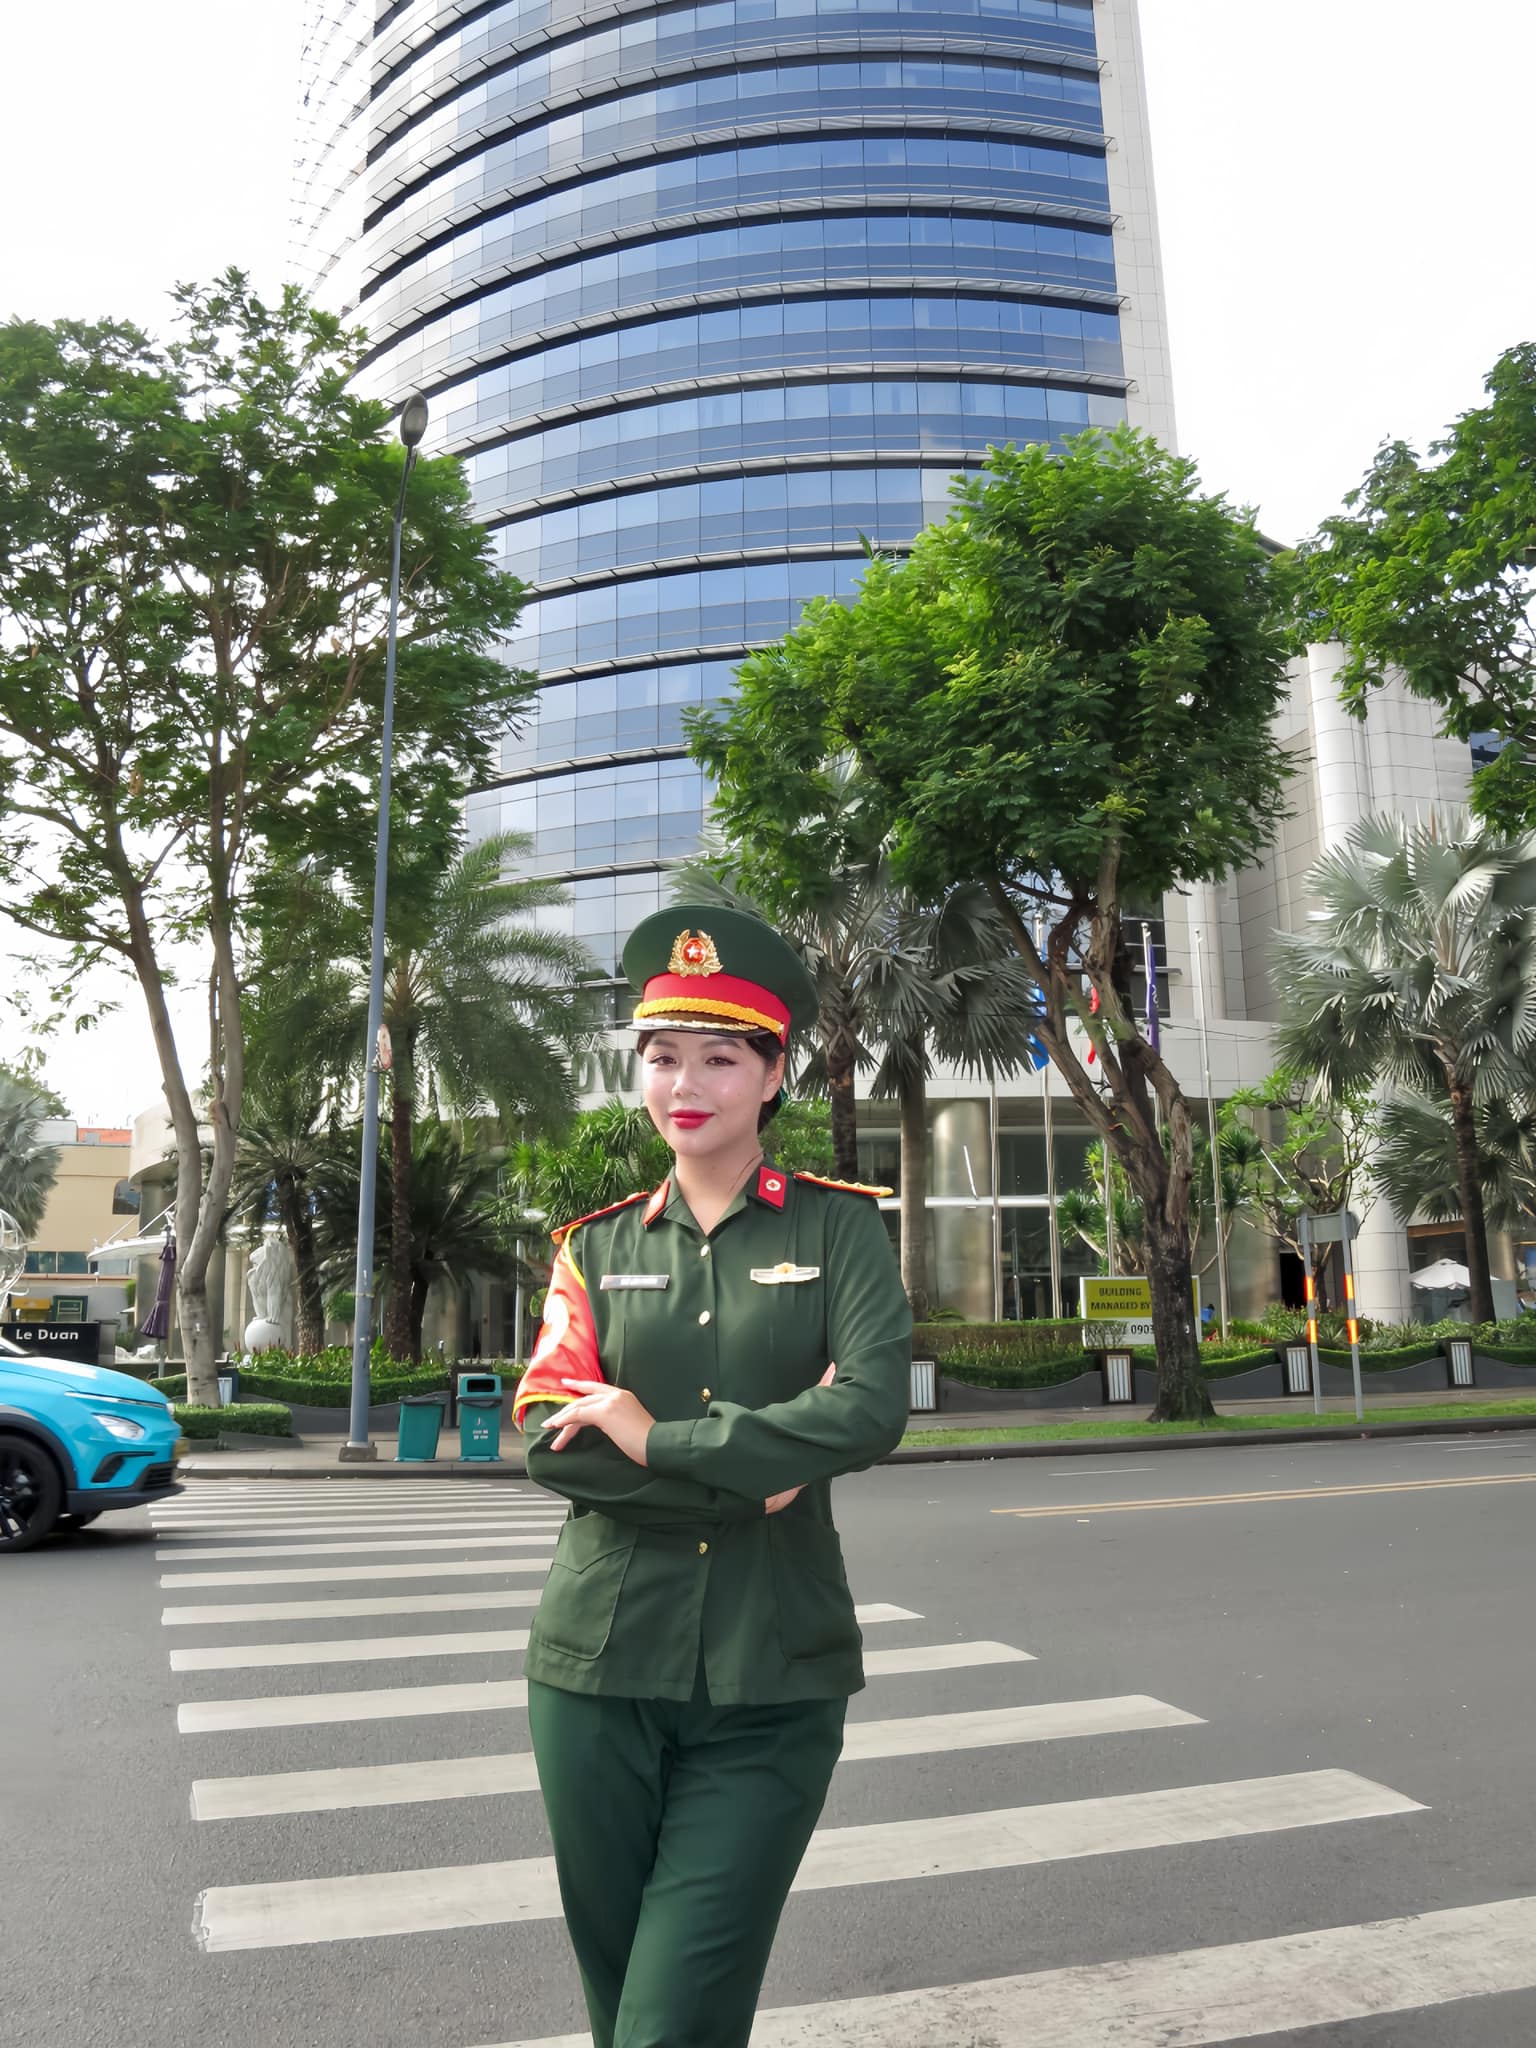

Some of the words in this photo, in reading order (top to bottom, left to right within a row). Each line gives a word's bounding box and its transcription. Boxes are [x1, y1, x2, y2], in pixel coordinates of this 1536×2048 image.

[1098, 1287, 1142, 1297] BUILDING
[1090, 1301, 1138, 1311] MANAGED
[15, 1328, 33, 1340] Le
[37, 1328, 79, 1340] Duan
